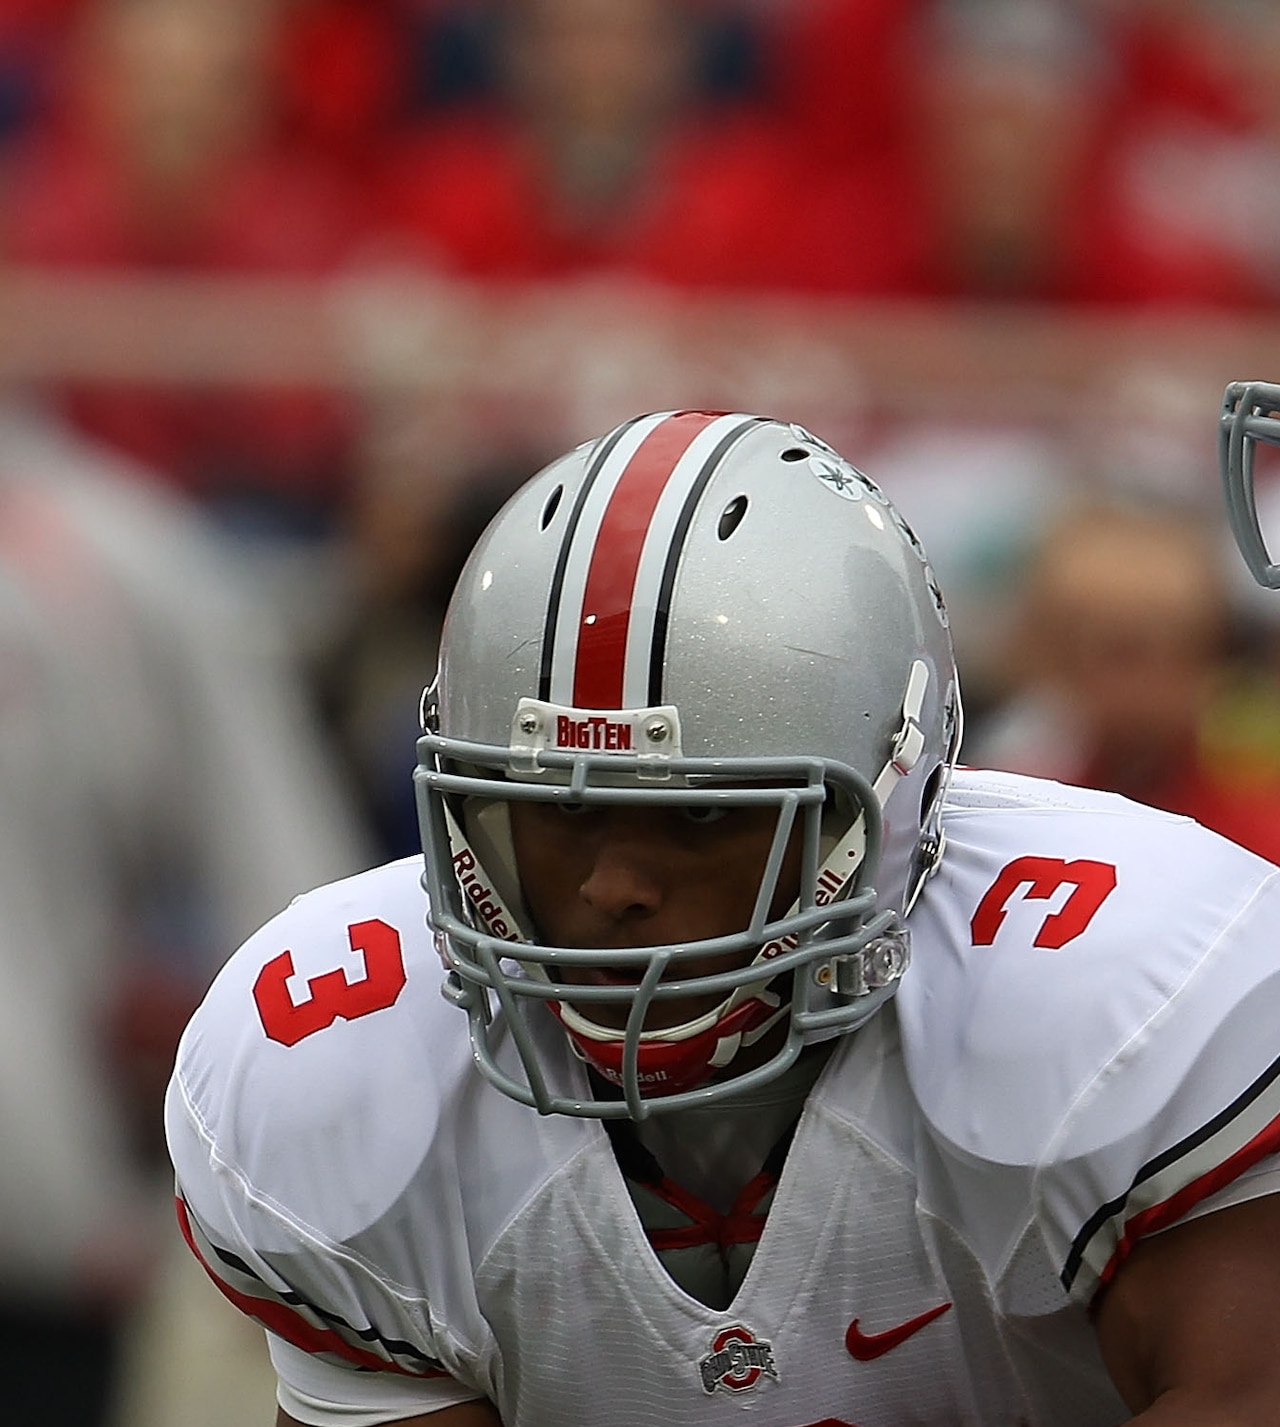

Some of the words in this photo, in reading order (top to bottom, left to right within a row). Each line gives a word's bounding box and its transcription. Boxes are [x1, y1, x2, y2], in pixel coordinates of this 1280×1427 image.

[452, 848, 522, 942] Riddel
[970, 856, 1117, 949] 3
[252, 918, 408, 1048] 3
